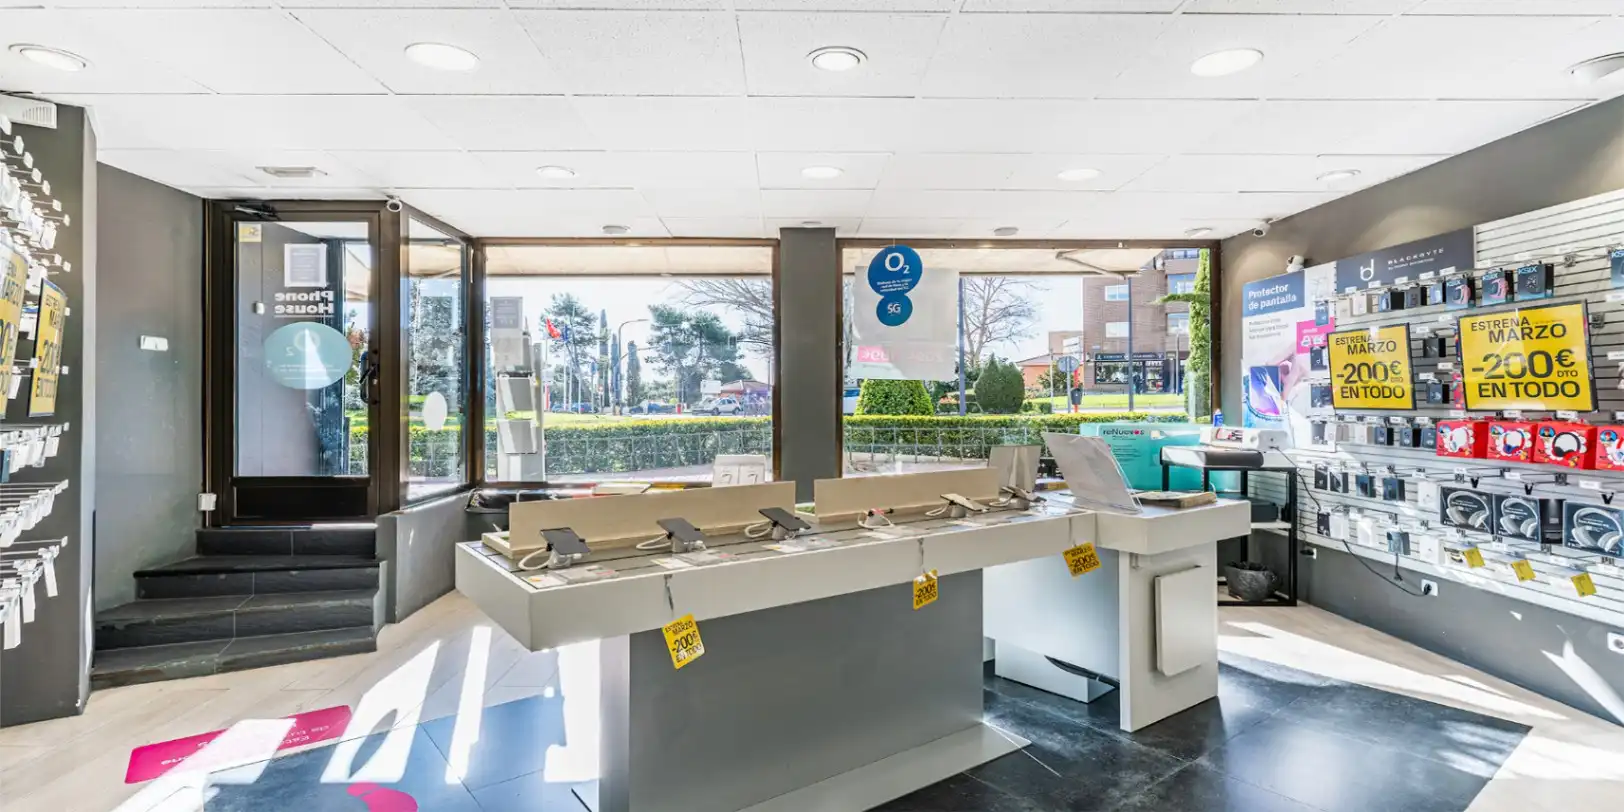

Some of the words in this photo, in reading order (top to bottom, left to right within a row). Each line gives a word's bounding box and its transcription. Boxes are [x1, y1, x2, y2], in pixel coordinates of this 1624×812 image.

[1517, 265, 1538, 275] KSIX
[1248, 284, 1289, 299] Protector
[887, 303, 901, 314] 5G
[1248, 301, 1259, 311] de
[1260, 293, 1297, 310] pantalla
[1471, 316, 1530, 332] ESTRENA
[1335, 335, 1373, 346] ESTRENA
[1488, 323, 1567, 343] MARZO
[1347, 340, 1397, 356] MARZO
[1472, 348, 1576, 380] -200€
[1336, 360, 1402, 385] -200€
[1557, 369, 1579, 378] DTO
[1340, 385, 1360, 399] EN
[1360, 384, 1405, 399] TODO
[1478, 382, 1508, 398] EN
[1509, 380, 1581, 398] TODO
[1102, 428, 1145, 437] reNuevos
